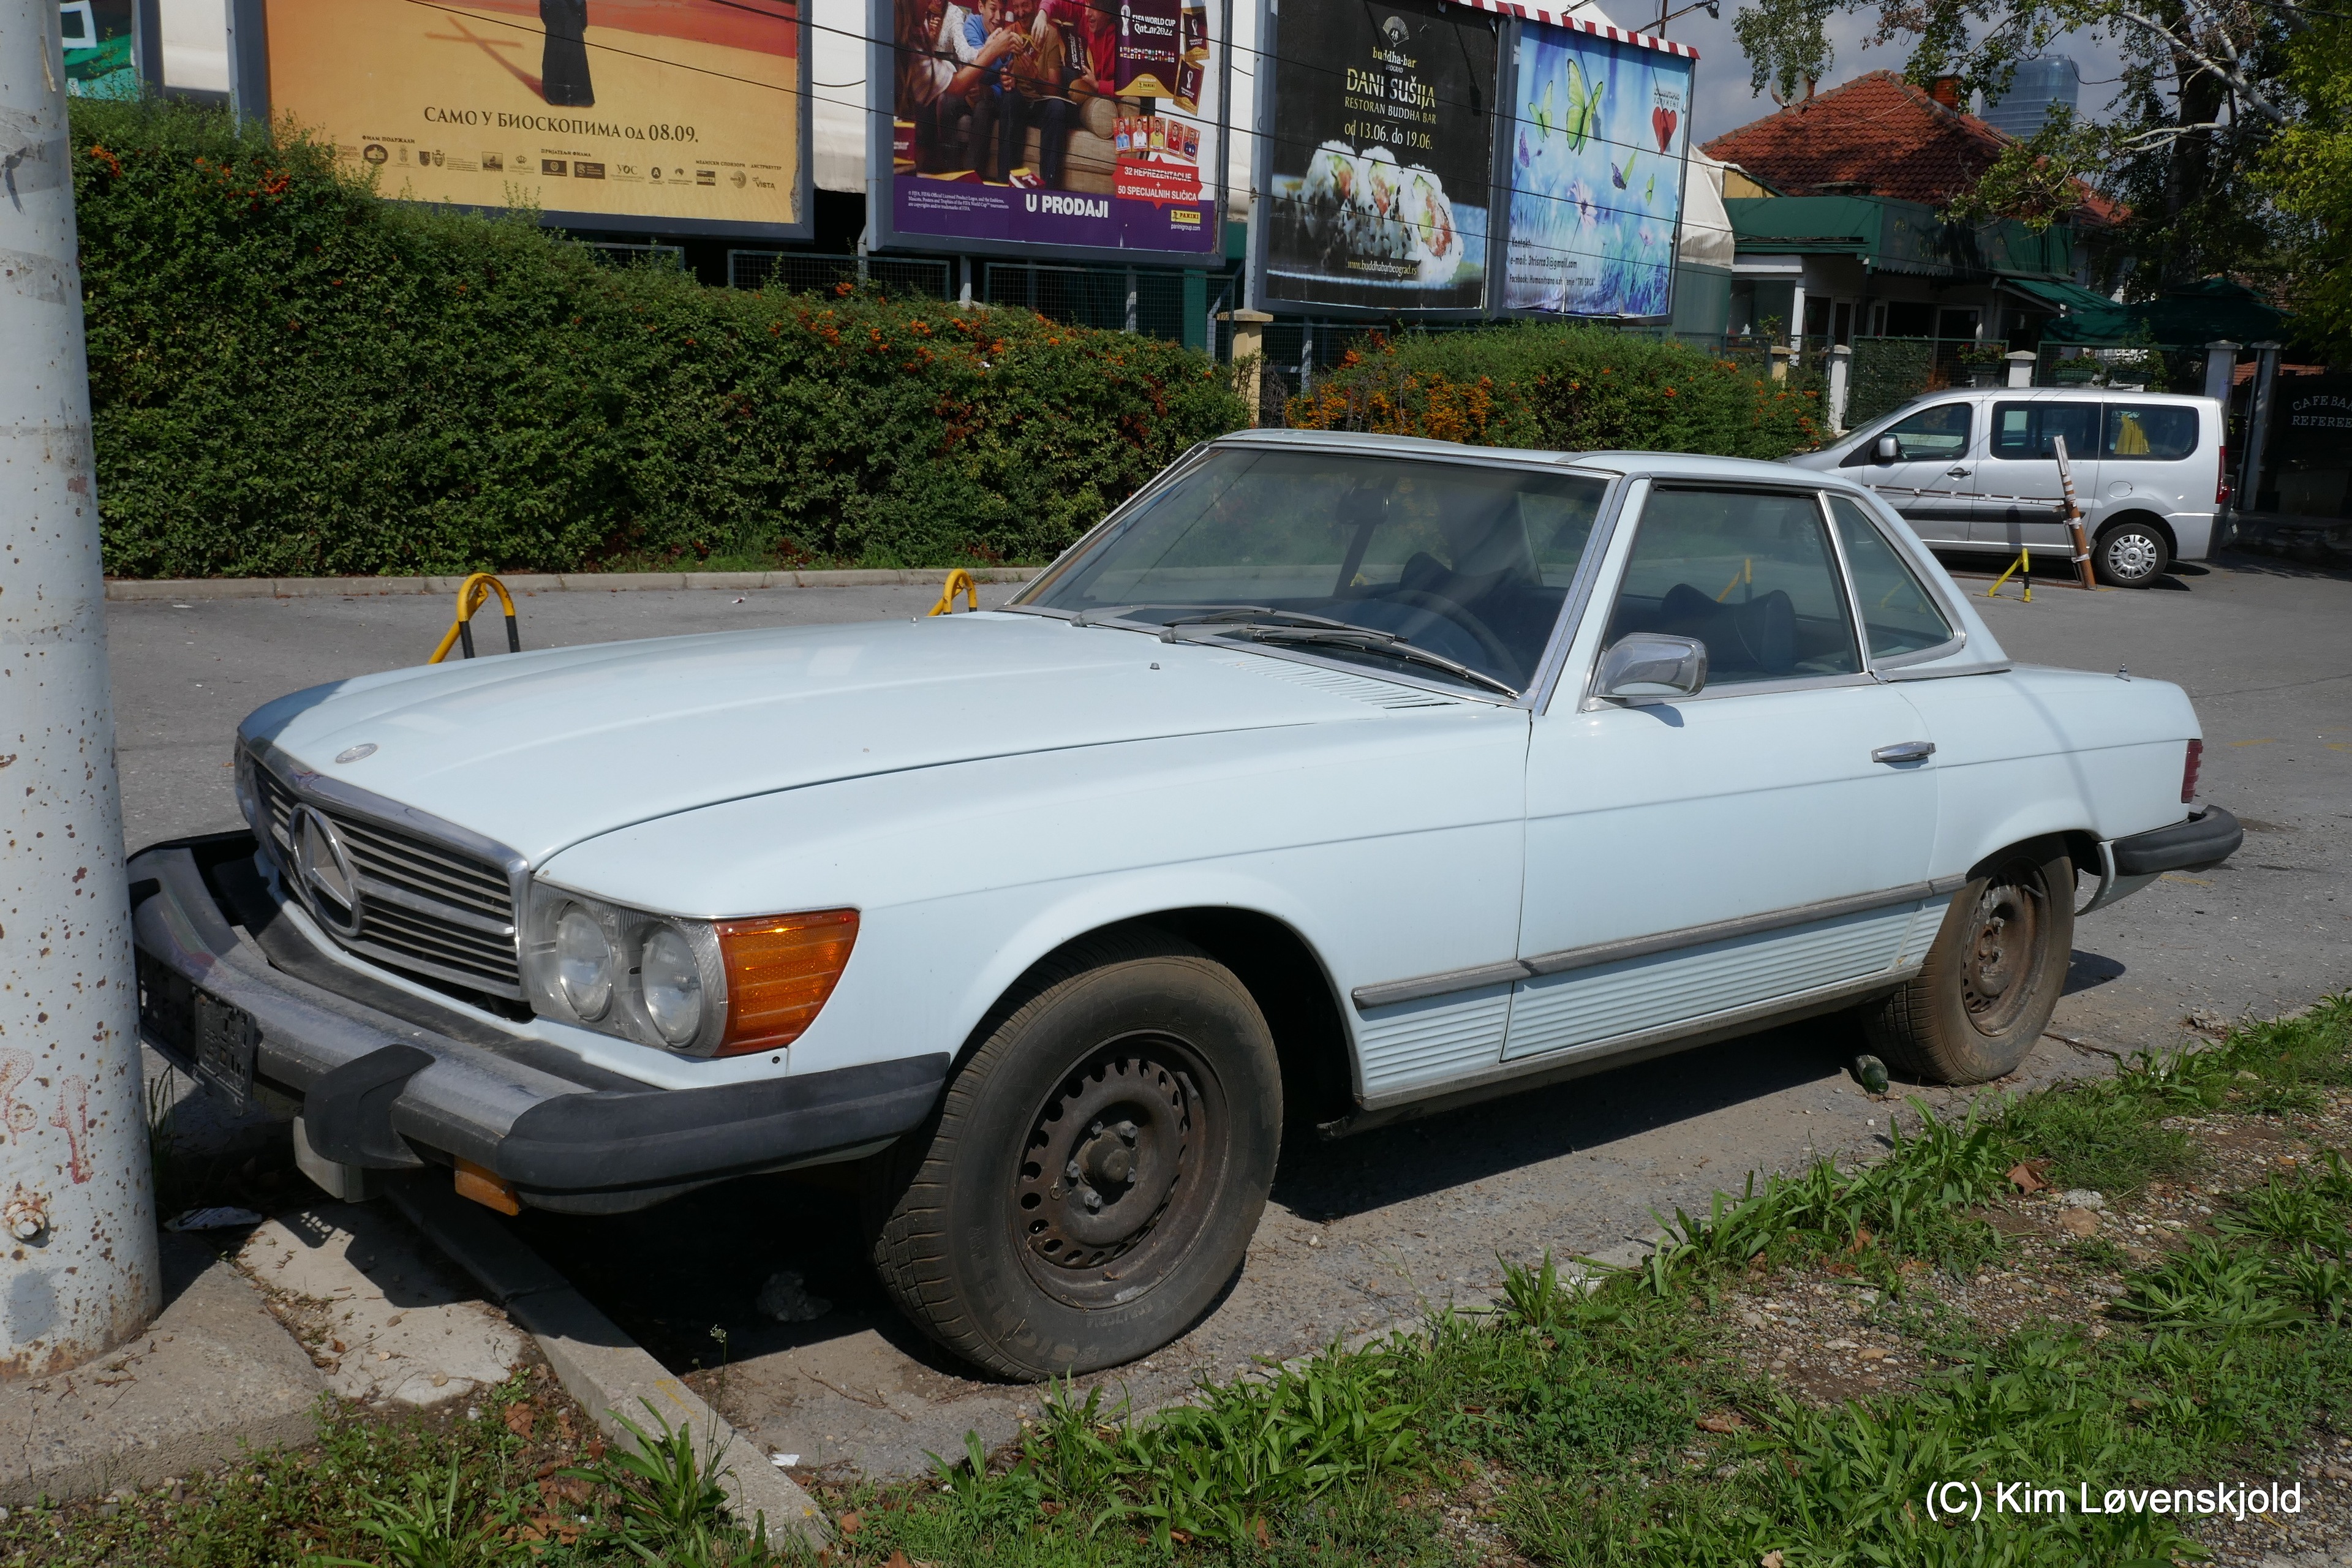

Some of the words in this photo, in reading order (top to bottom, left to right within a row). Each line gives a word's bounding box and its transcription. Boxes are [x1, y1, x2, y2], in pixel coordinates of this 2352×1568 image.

[1145, 17, 1164, 26] WORLD
[1373, 47, 1415, 69] buddha-bar
[1385, 64, 1403, 74] BEOGRAD
[1346, 68, 1385, 98] DANI
[1389, 75, 1436, 110] SUŠIJA
[1344, 96, 1385, 115] RESTORAN
[1388, 105, 1420, 122] BUDDHA
[1423, 112, 1436, 125] BAR
[424, 107, 477, 126] САМО
[481, 111, 492, 126] У
[498, 113, 621, 138] БИОСКОПИМА
[649, 124, 698, 143] 08.09.
[1344, 120, 1356, 136] od
[1360, 123, 1389, 142] 13.06.
[1392, 127, 1403, 145] do
[1407, 131, 1433, 150] 19.06.
[1125, 167, 1133, 175] 32
[1134, 167, 1192, 182] REPREZENTACIJE
[1118, 186, 1126, 195] 50
[1127, 186, 1170, 199] SPECIJALNIH
[1172, 189, 1197, 202] SLIČICA
[1026, 194, 1037, 212] U
[1042, 196, 1109, 218] PRODAJI
[1511, 236, 1532, 248] Kontakt:
[1348, 260, 1417, 277] www.buddhabarbeograd.rs
[1510, 255, 1527, 266] e-mail:
[1528, 255, 1577, 270] 3trisrca3@gmail.com
[1509, 274, 1529, 284] Facebook:
[2293, 396, 2329, 411] CAFE
